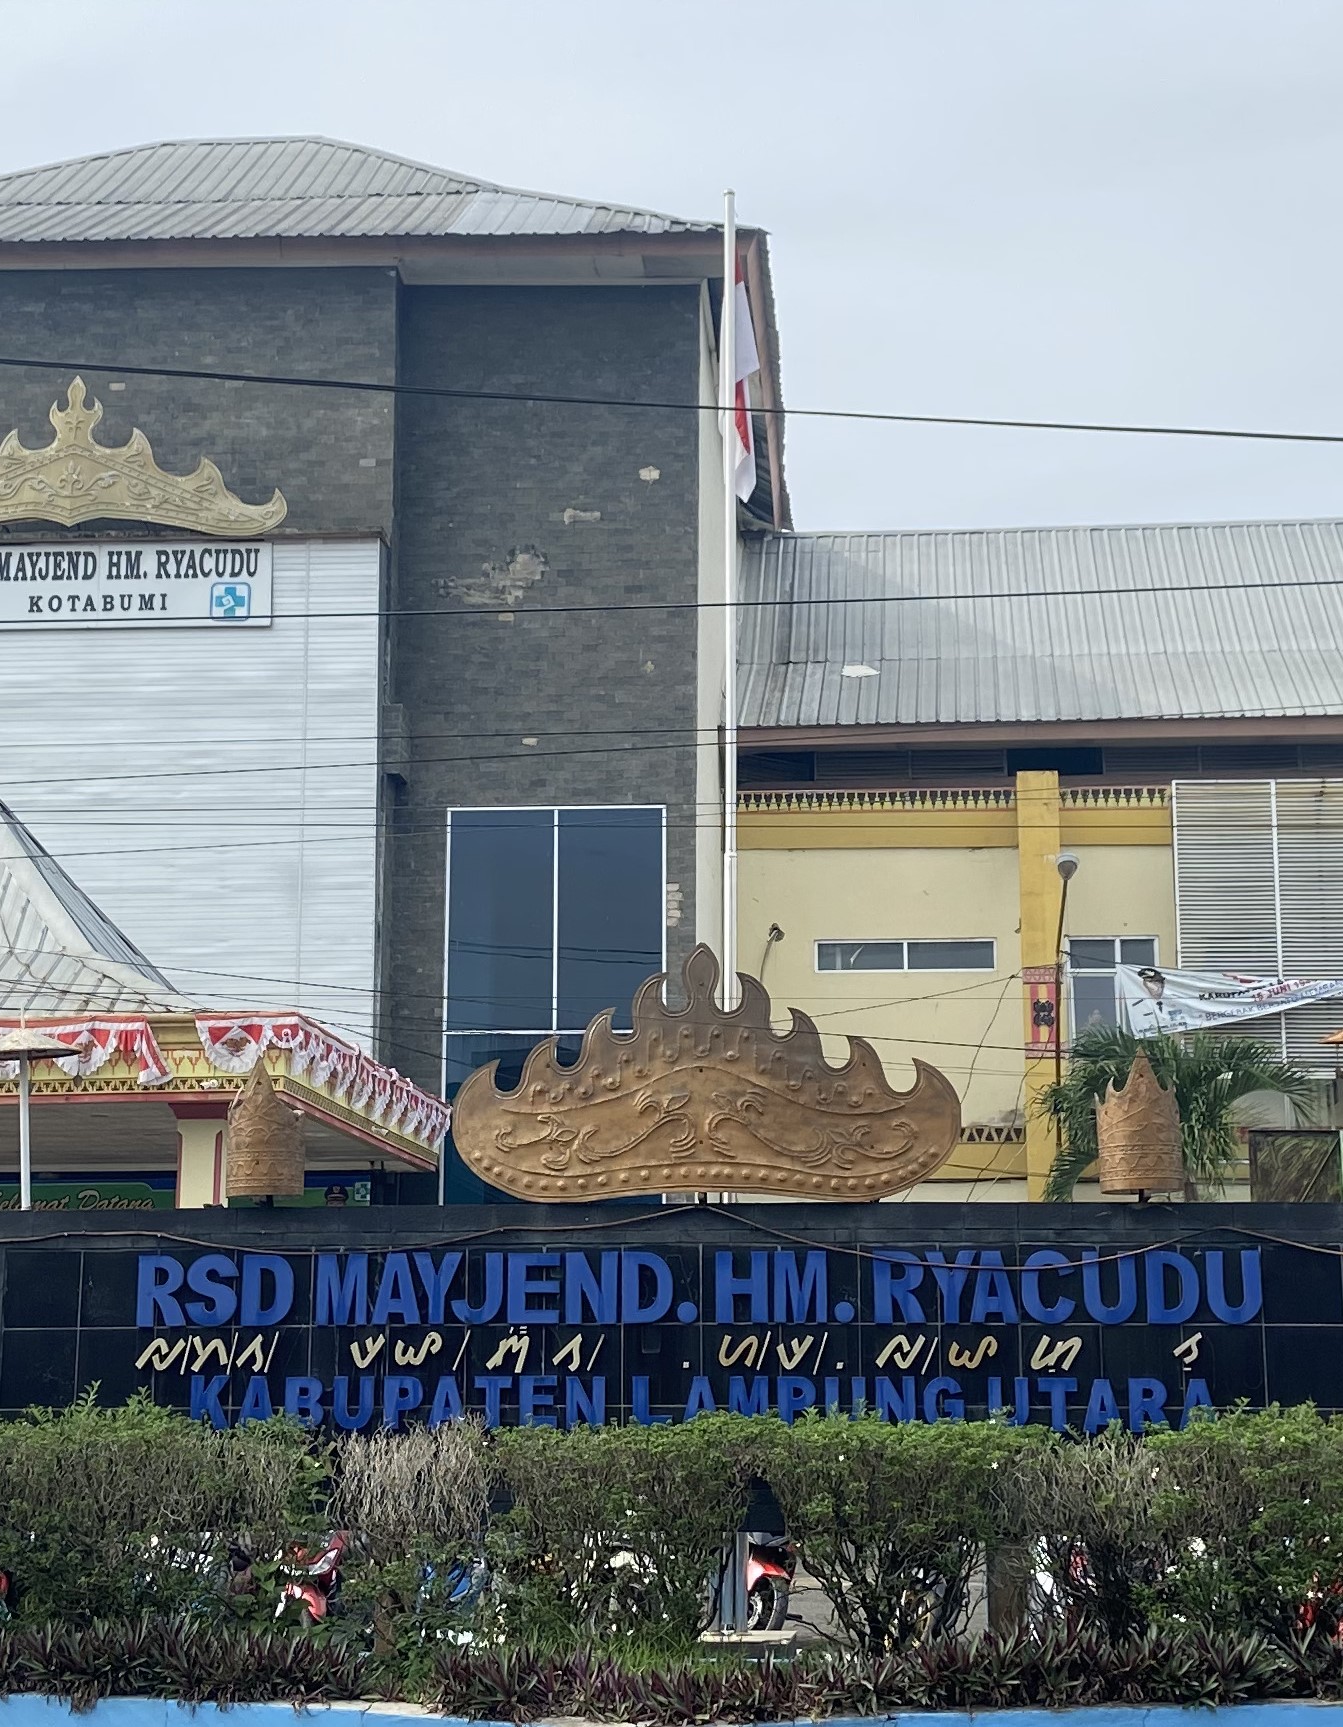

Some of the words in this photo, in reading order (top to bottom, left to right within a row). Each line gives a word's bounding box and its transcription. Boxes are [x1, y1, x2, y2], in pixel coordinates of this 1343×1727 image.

[106, 549, 148, 580] HM.
[155, 547, 261, 580] RYACUDU
[28, 593, 168, 613] KOTABUMI
[135, 1254, 294, 1328] RSD
[314, 1251, 698, 1326] MAYJEND.
[715, 1250, 855, 1325] HM.
[873, 1249, 1263, 1325] RYACUDU
[190, 1375, 606, 1430] KABUPATEN
[988, 1376, 1213, 1434] UTARA
